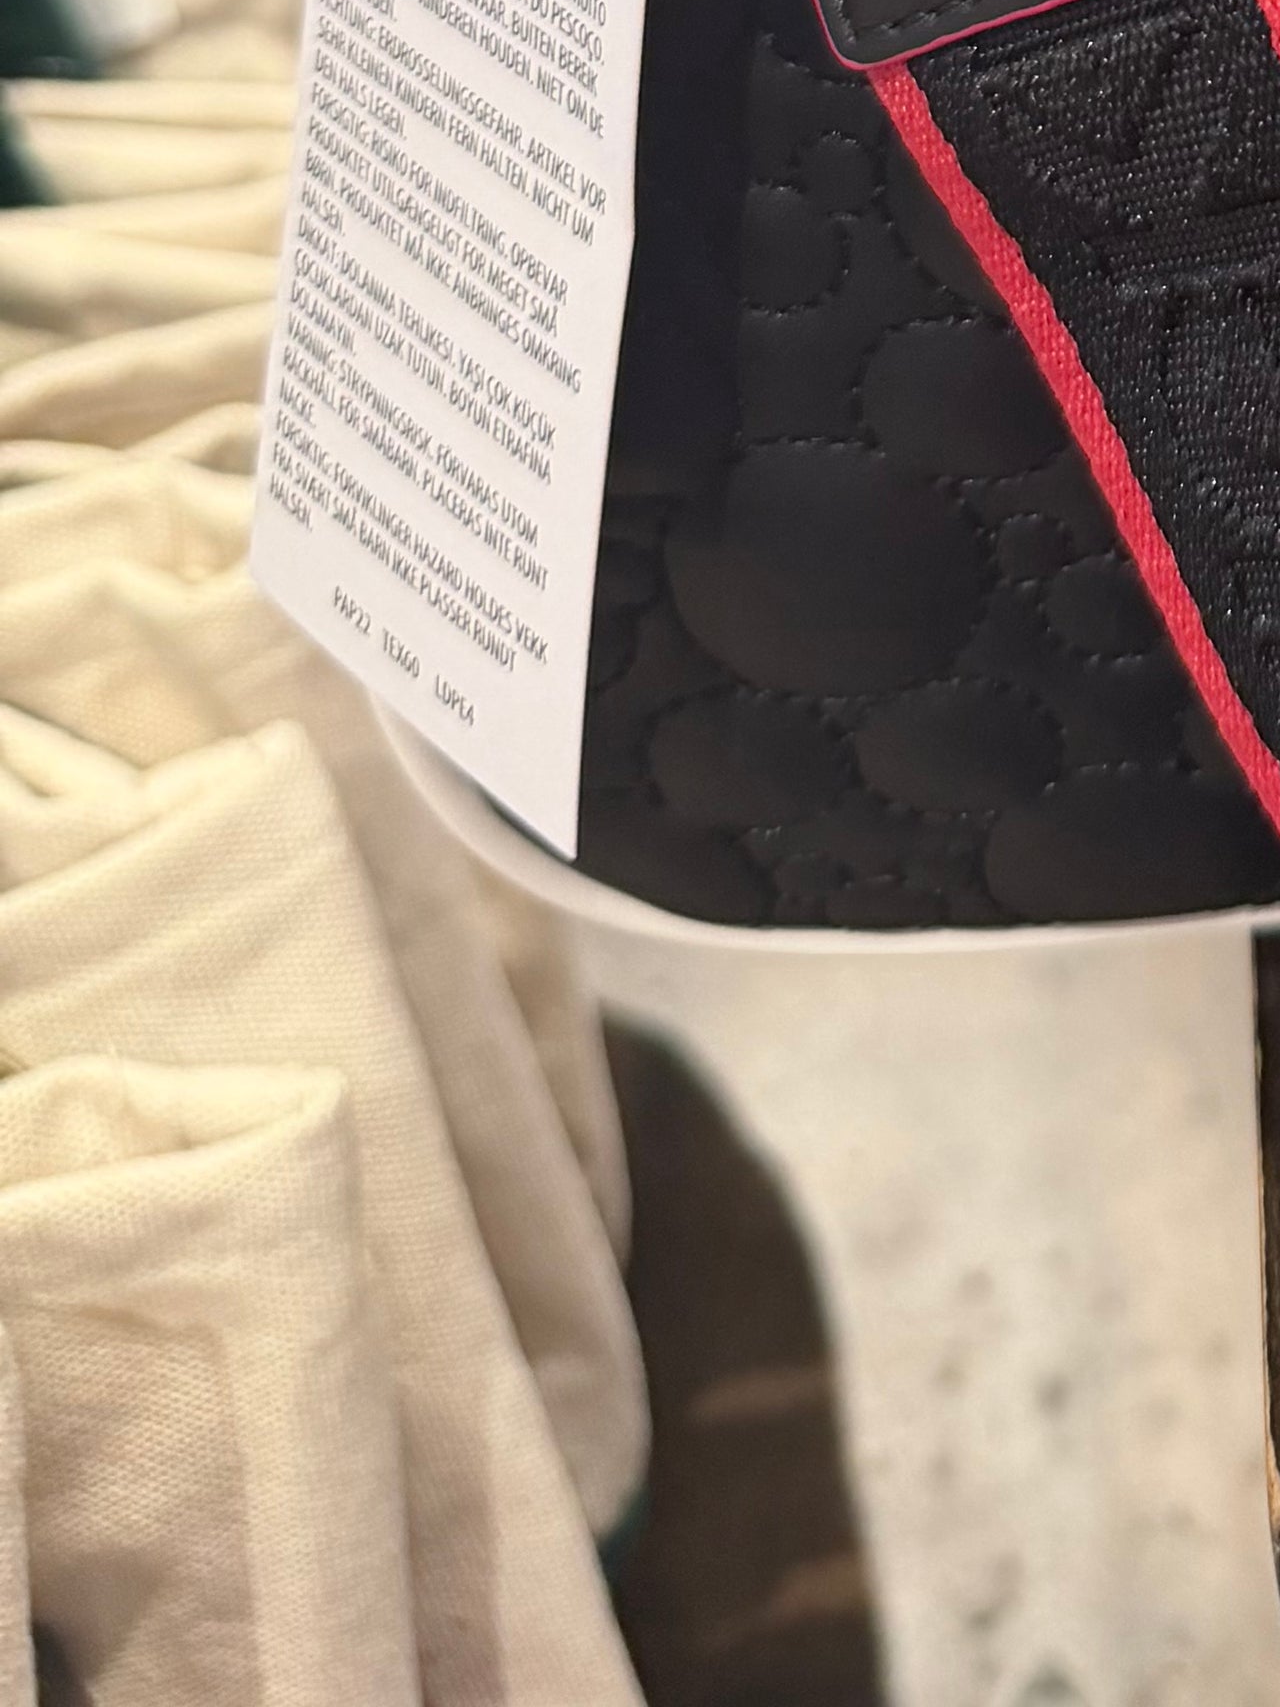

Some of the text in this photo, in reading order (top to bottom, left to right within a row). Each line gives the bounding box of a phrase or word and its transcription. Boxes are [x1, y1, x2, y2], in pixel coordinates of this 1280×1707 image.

[510, 10, 556, 62] BUITEN
[558, 43, 597, 96] BEREIK
[334, 585, 371, 634] PAP22
[434, 673, 474, 726] LDPE4
